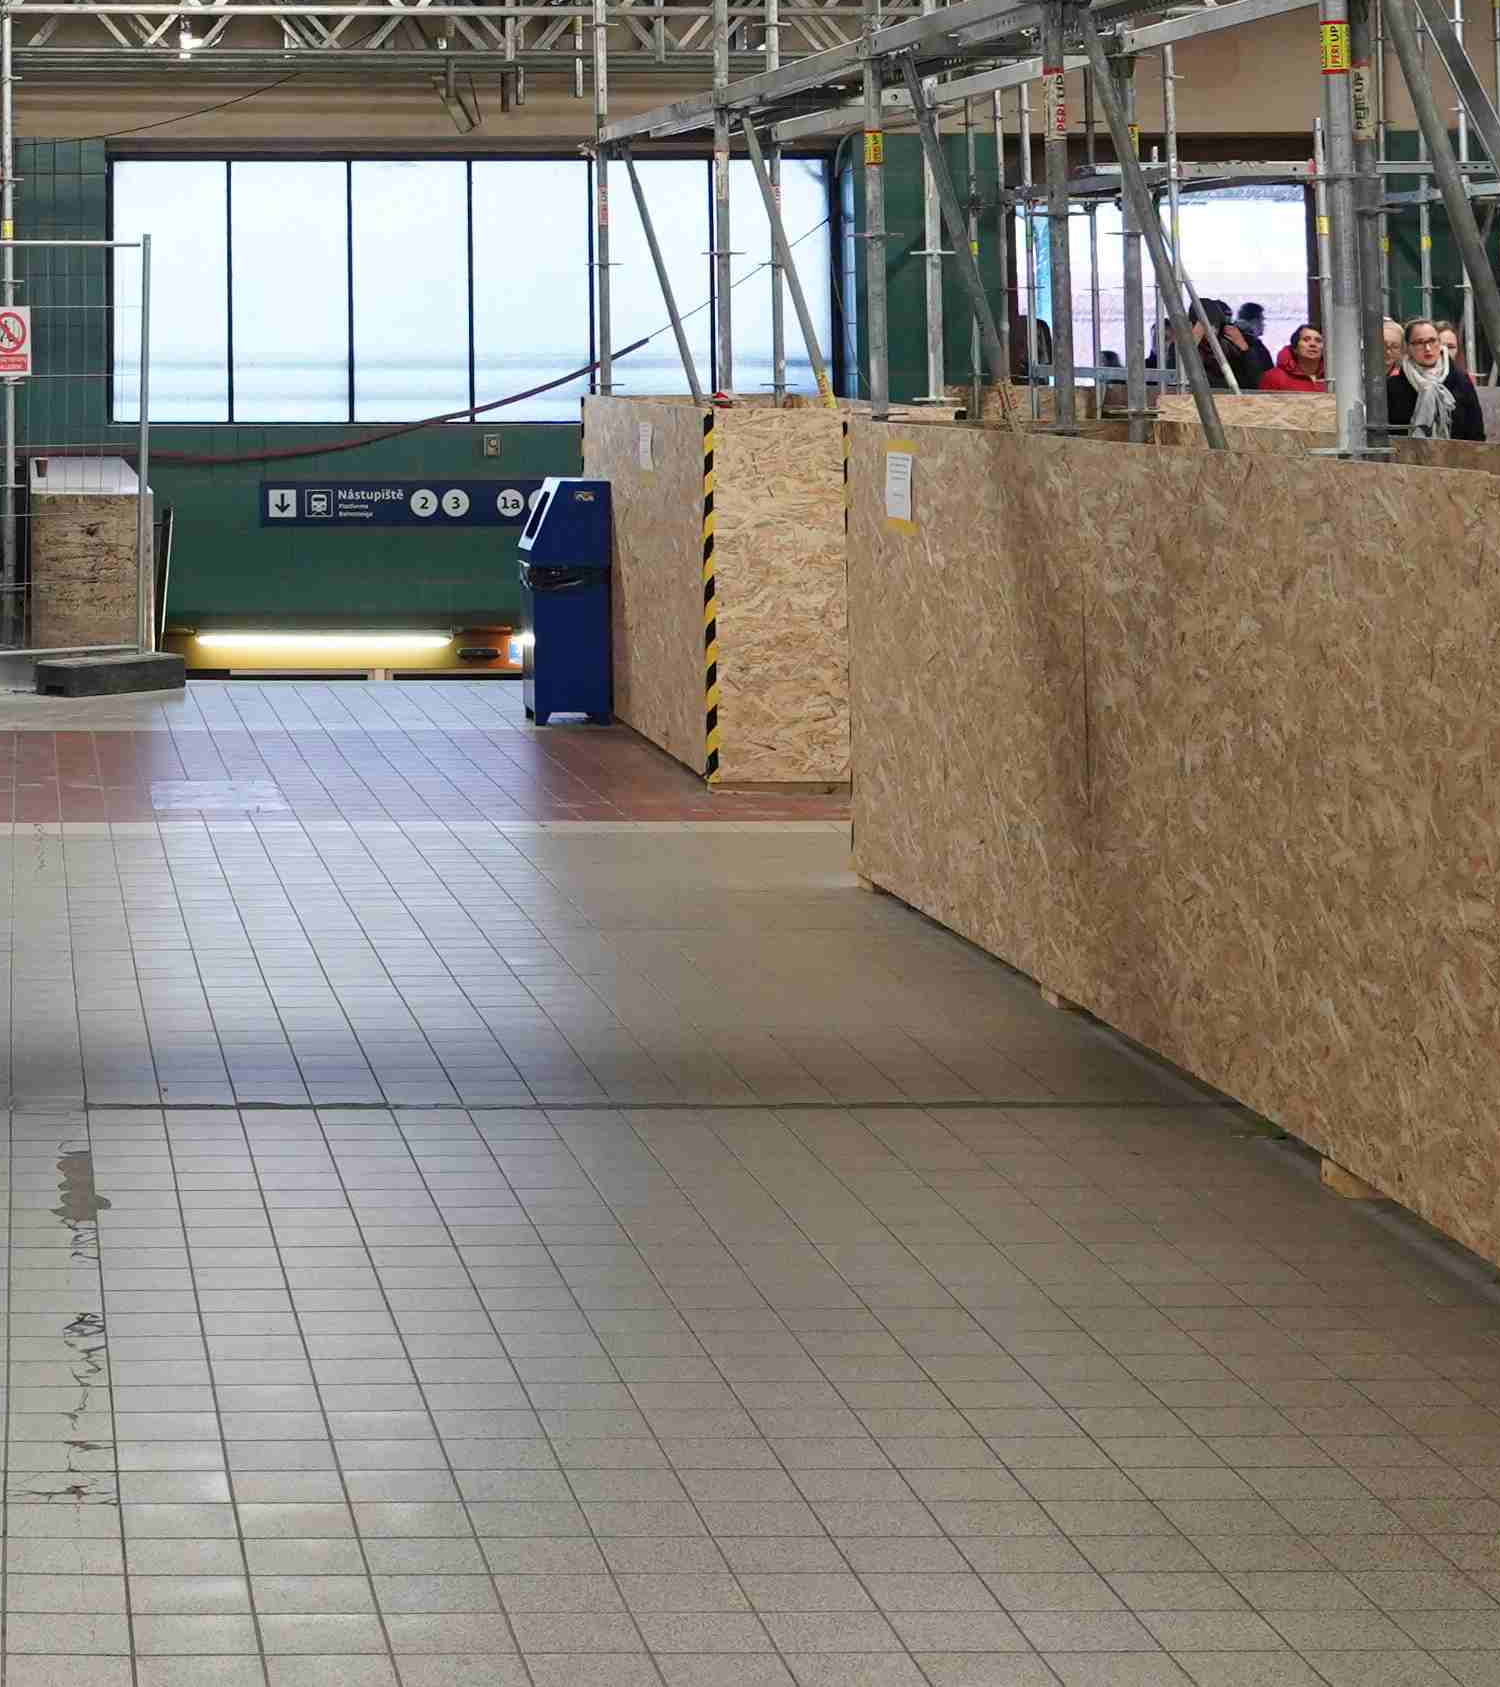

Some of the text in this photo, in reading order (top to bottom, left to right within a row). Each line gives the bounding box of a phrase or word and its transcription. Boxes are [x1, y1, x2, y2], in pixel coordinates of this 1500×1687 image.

[1329, 25, 1340, 64] PERI UP
[1056, 104, 1066, 132] PERI
[337, 489, 404, 502] Nástupiště
[419, 496, 429, 509] 2
[452, 496, 460, 509] 3
[501, 496, 519, 509] 1a
